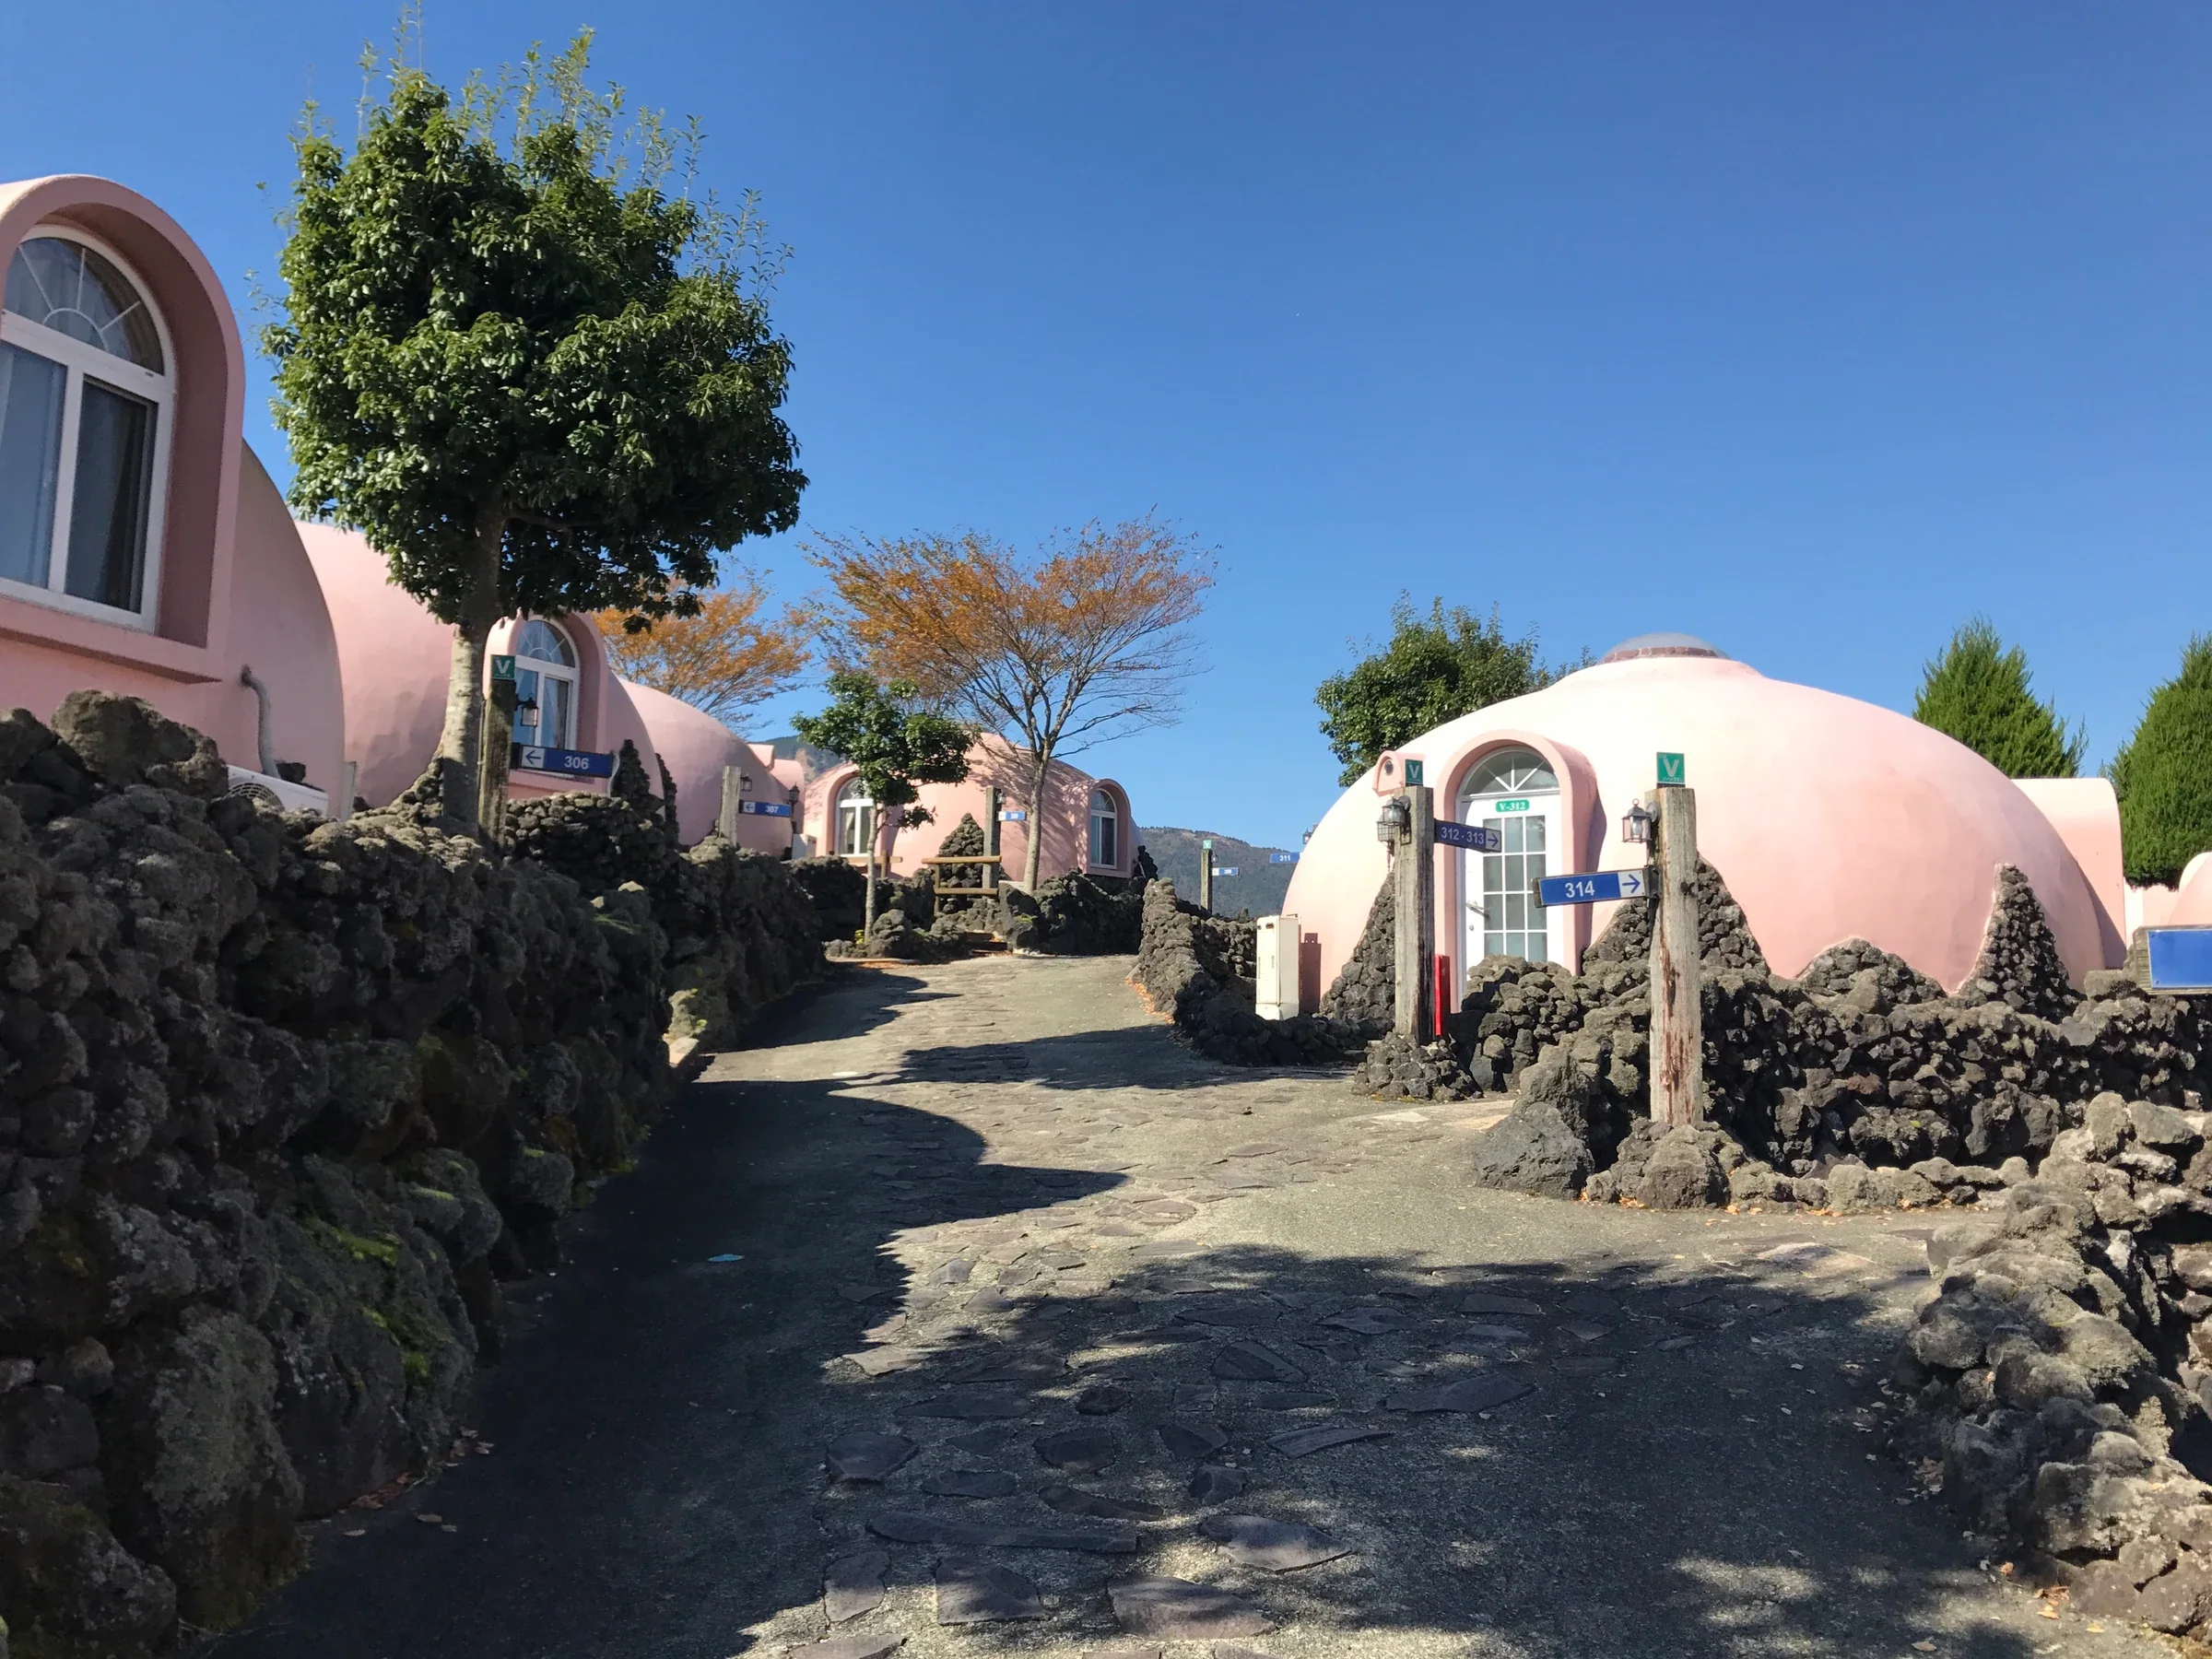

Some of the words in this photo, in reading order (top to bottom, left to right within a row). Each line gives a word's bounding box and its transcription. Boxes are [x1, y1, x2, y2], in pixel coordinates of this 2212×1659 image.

[495, 659, 511, 674] V
[564, 756, 589, 770] 306
[1663, 759, 1680, 777] V
[1408, 764, 1420, 779] V
[765, 805, 780, 814] 307
[1499, 802, 1526, 811] V-312
[1564, 880, 1595, 899] 314
